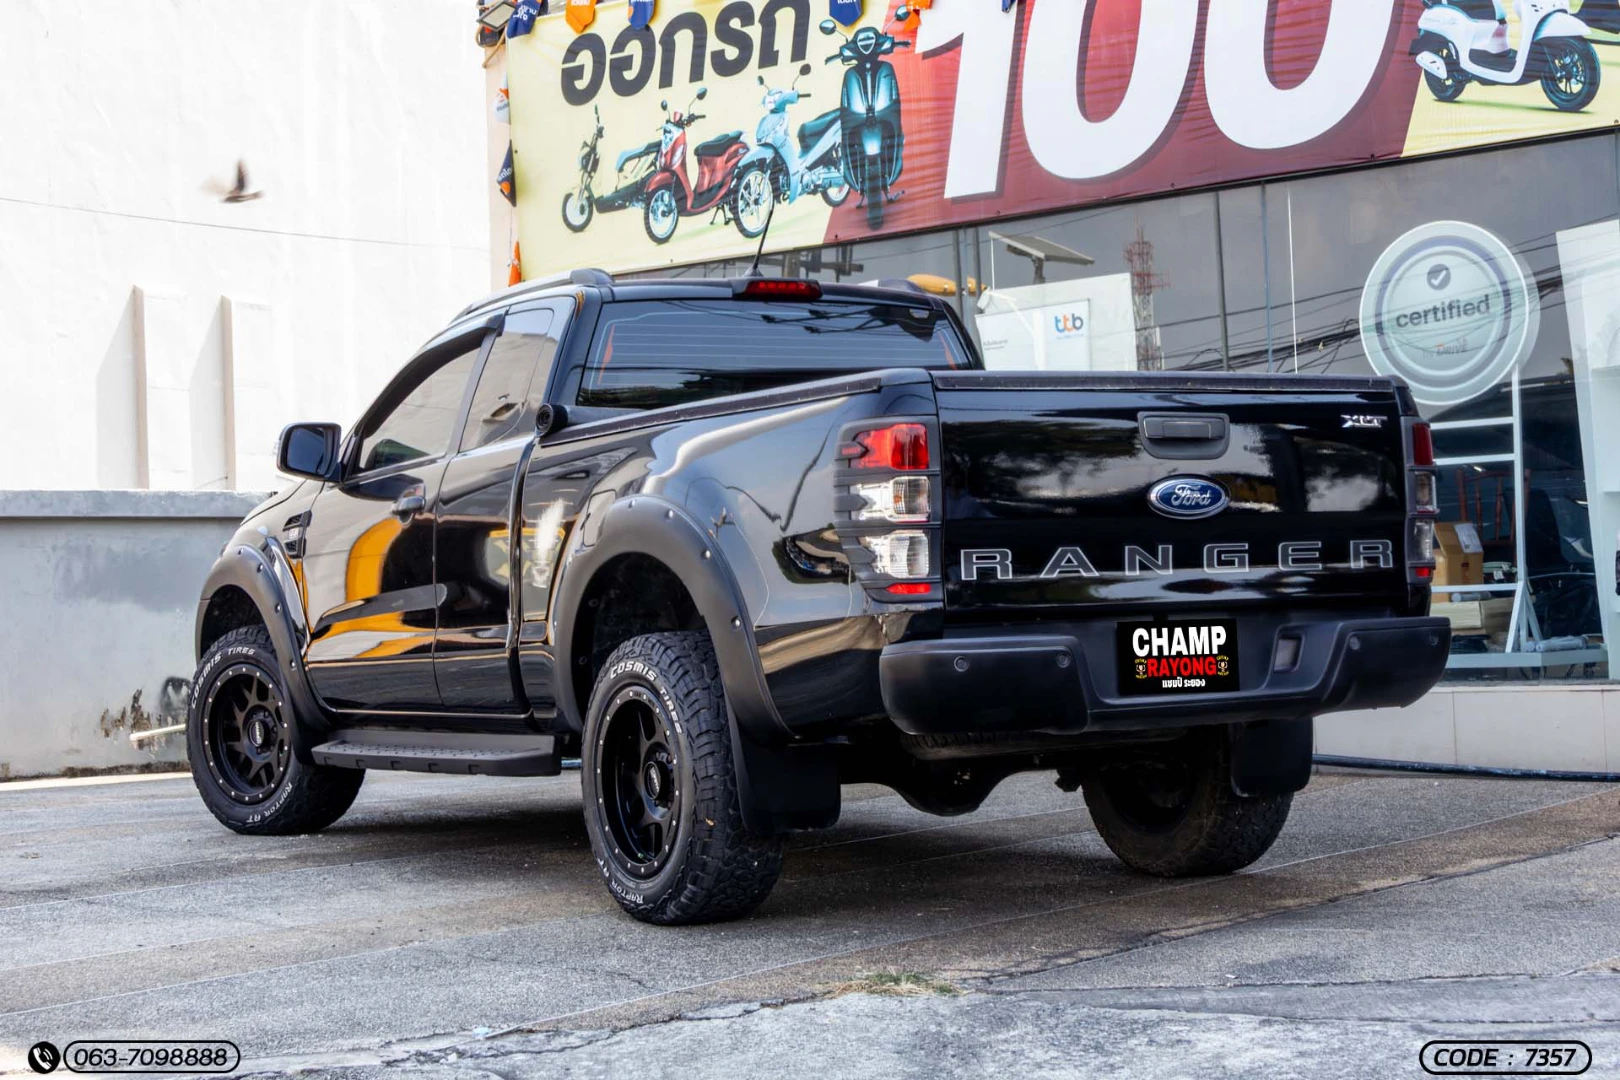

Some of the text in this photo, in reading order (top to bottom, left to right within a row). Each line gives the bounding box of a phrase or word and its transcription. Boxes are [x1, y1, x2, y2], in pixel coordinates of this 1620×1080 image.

[561, 0, 810, 106] ออกรถ
[1054, 313, 1084, 333] ttb
[1396, 294, 1490, 328] certified
[1341, 415, 1387, 428] XLT
[1171, 484, 1211, 506] Ford
[960, 539, 1395, 581] RANGER
[191, 646, 256, 710] COSMIS TIRES
[610, 660, 683, 734] COSMIS TIRES
[263, 781, 294, 818] RAPTOR
